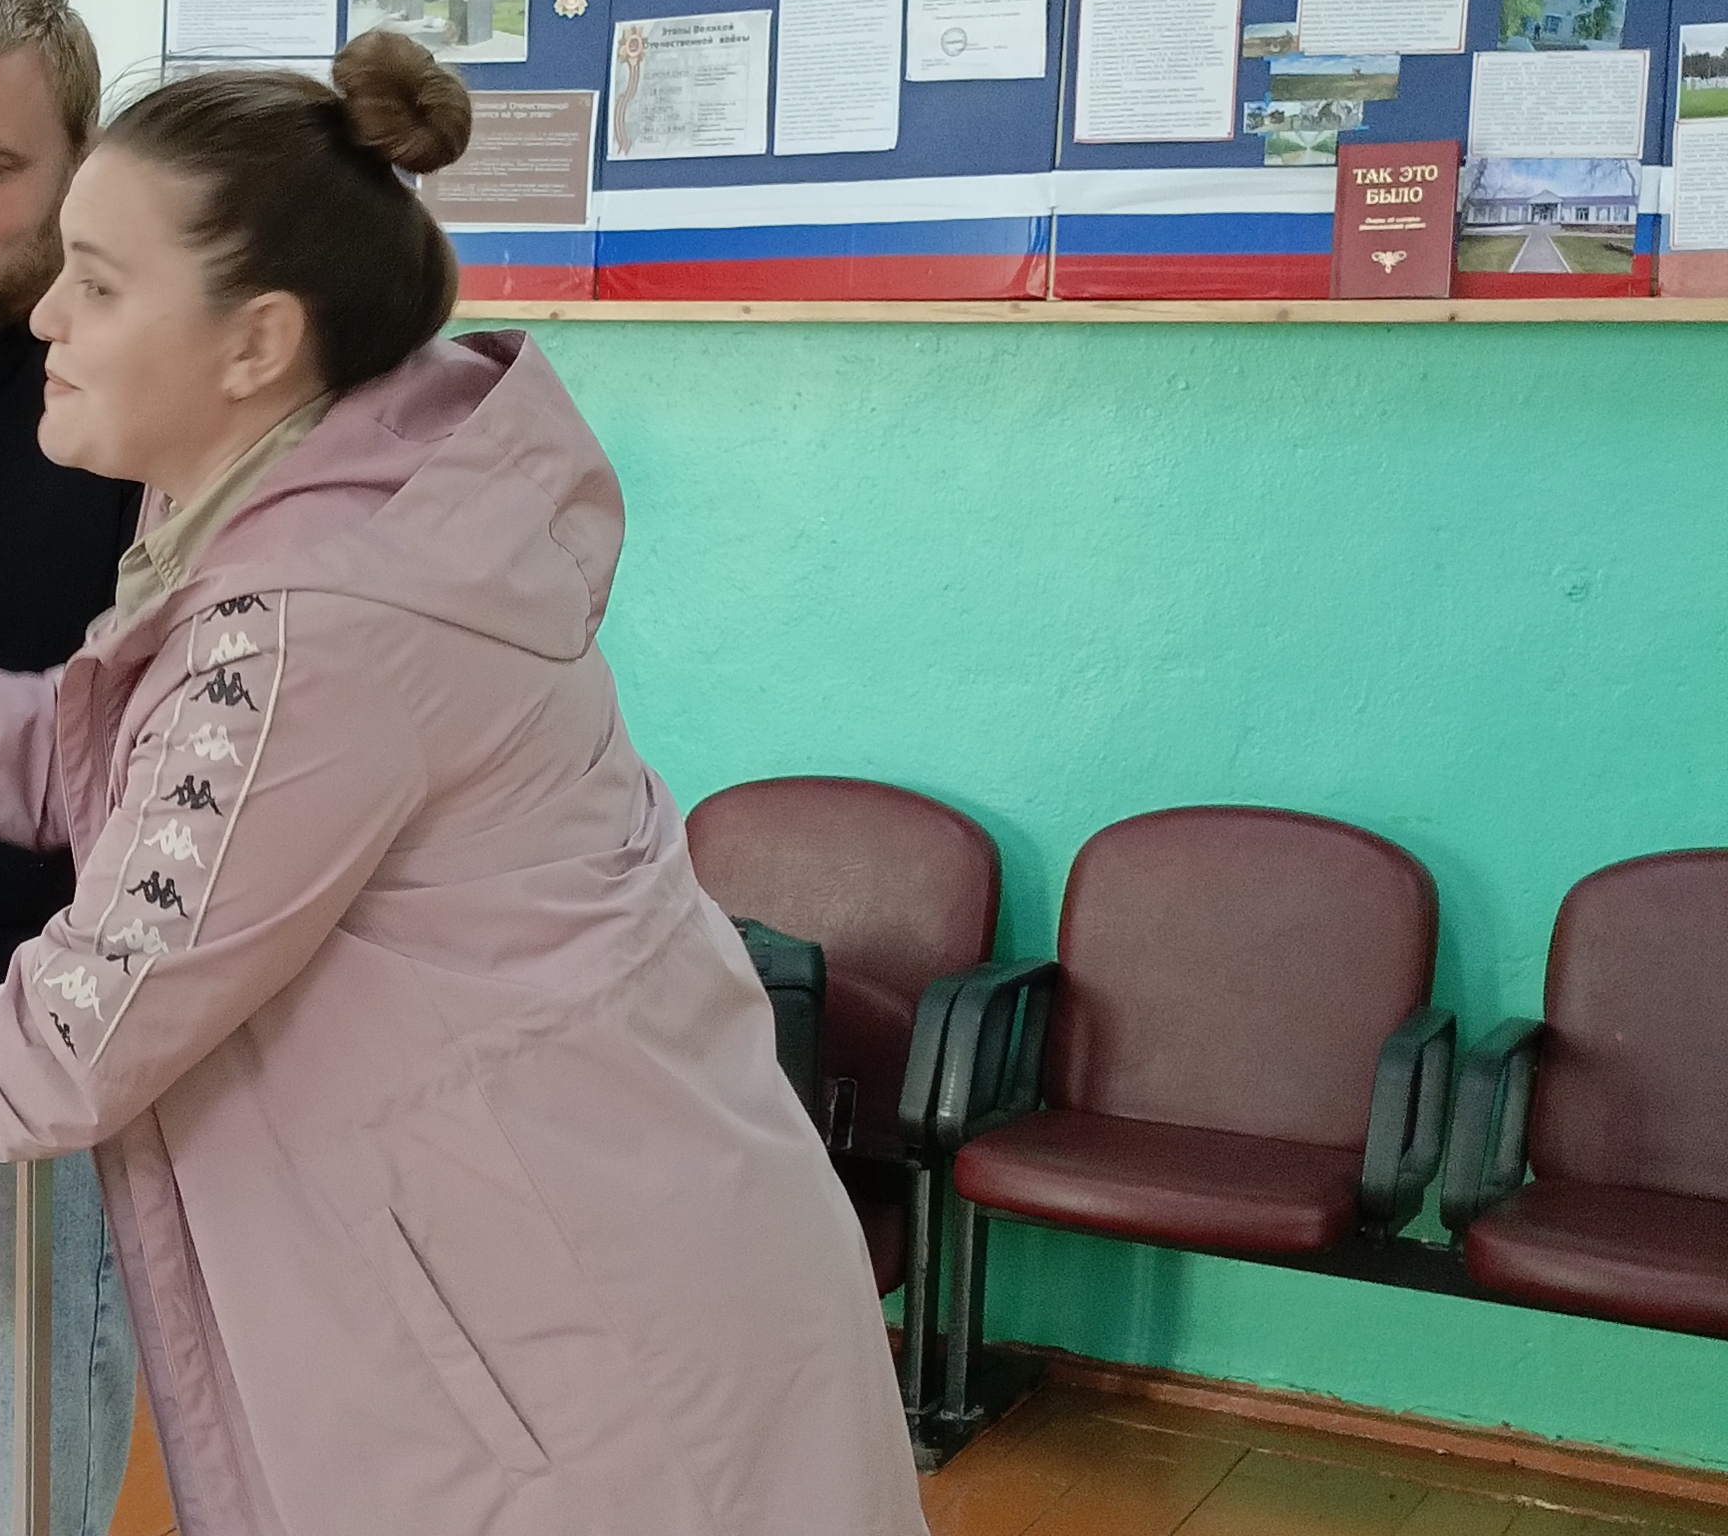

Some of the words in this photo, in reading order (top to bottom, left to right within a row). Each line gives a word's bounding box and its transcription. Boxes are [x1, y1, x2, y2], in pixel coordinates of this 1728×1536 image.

[1352, 166, 1394, 185] ТАК
[1399, 164, 1439, 183] ЭТО
[1365, 186, 1423, 206] БЫЛО
